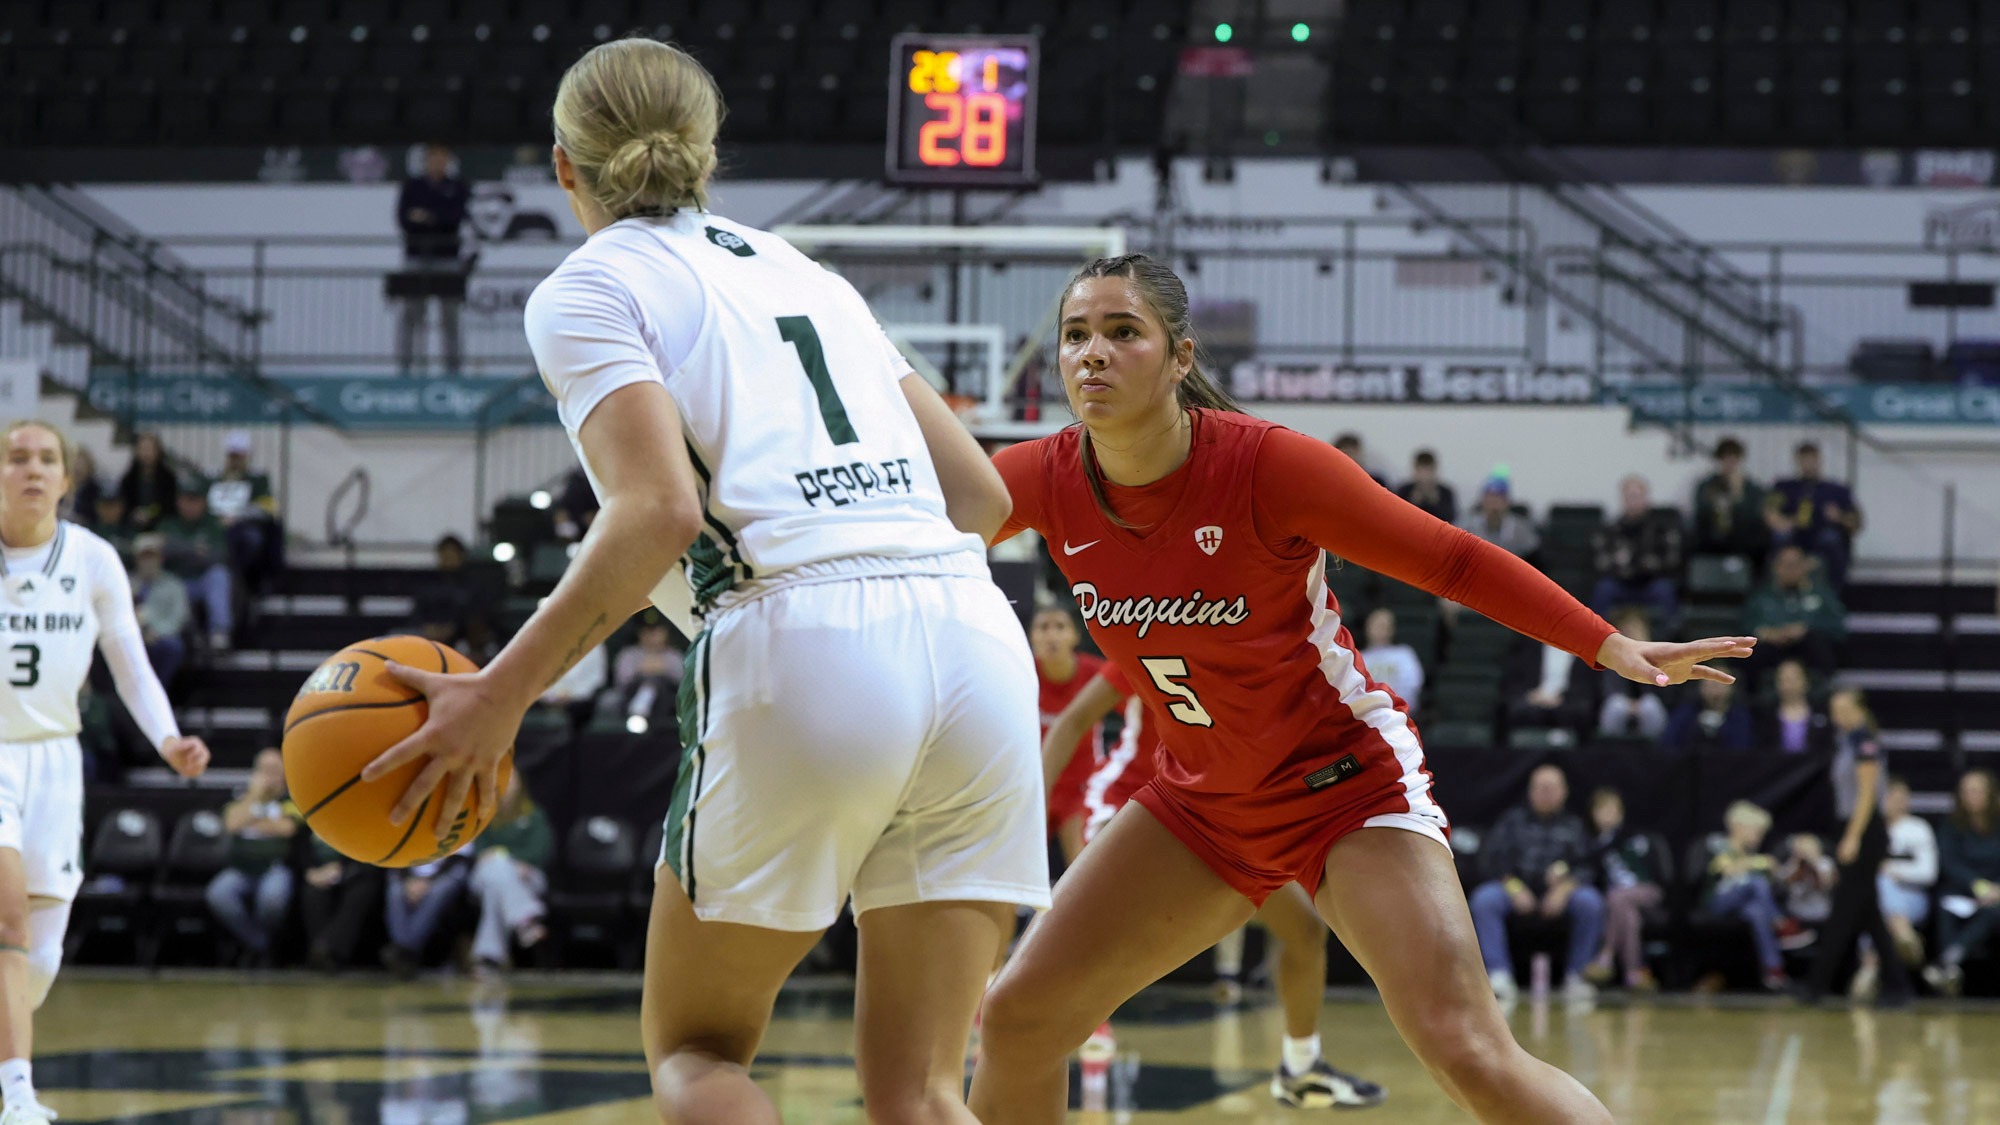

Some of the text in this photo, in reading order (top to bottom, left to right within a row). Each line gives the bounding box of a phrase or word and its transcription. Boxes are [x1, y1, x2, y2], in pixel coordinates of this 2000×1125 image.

[918, 91, 1007, 167] 28
[775, 315, 860, 446] 1
[1231, 360, 1592, 400] Student Section
[45, 612, 84, 634] BAY
[1072, 581, 1251, 639] Penguins
[9, 643, 41, 688] 3
[1137, 655, 1215, 729] 5
[1340, 761, 1353, 772] M
